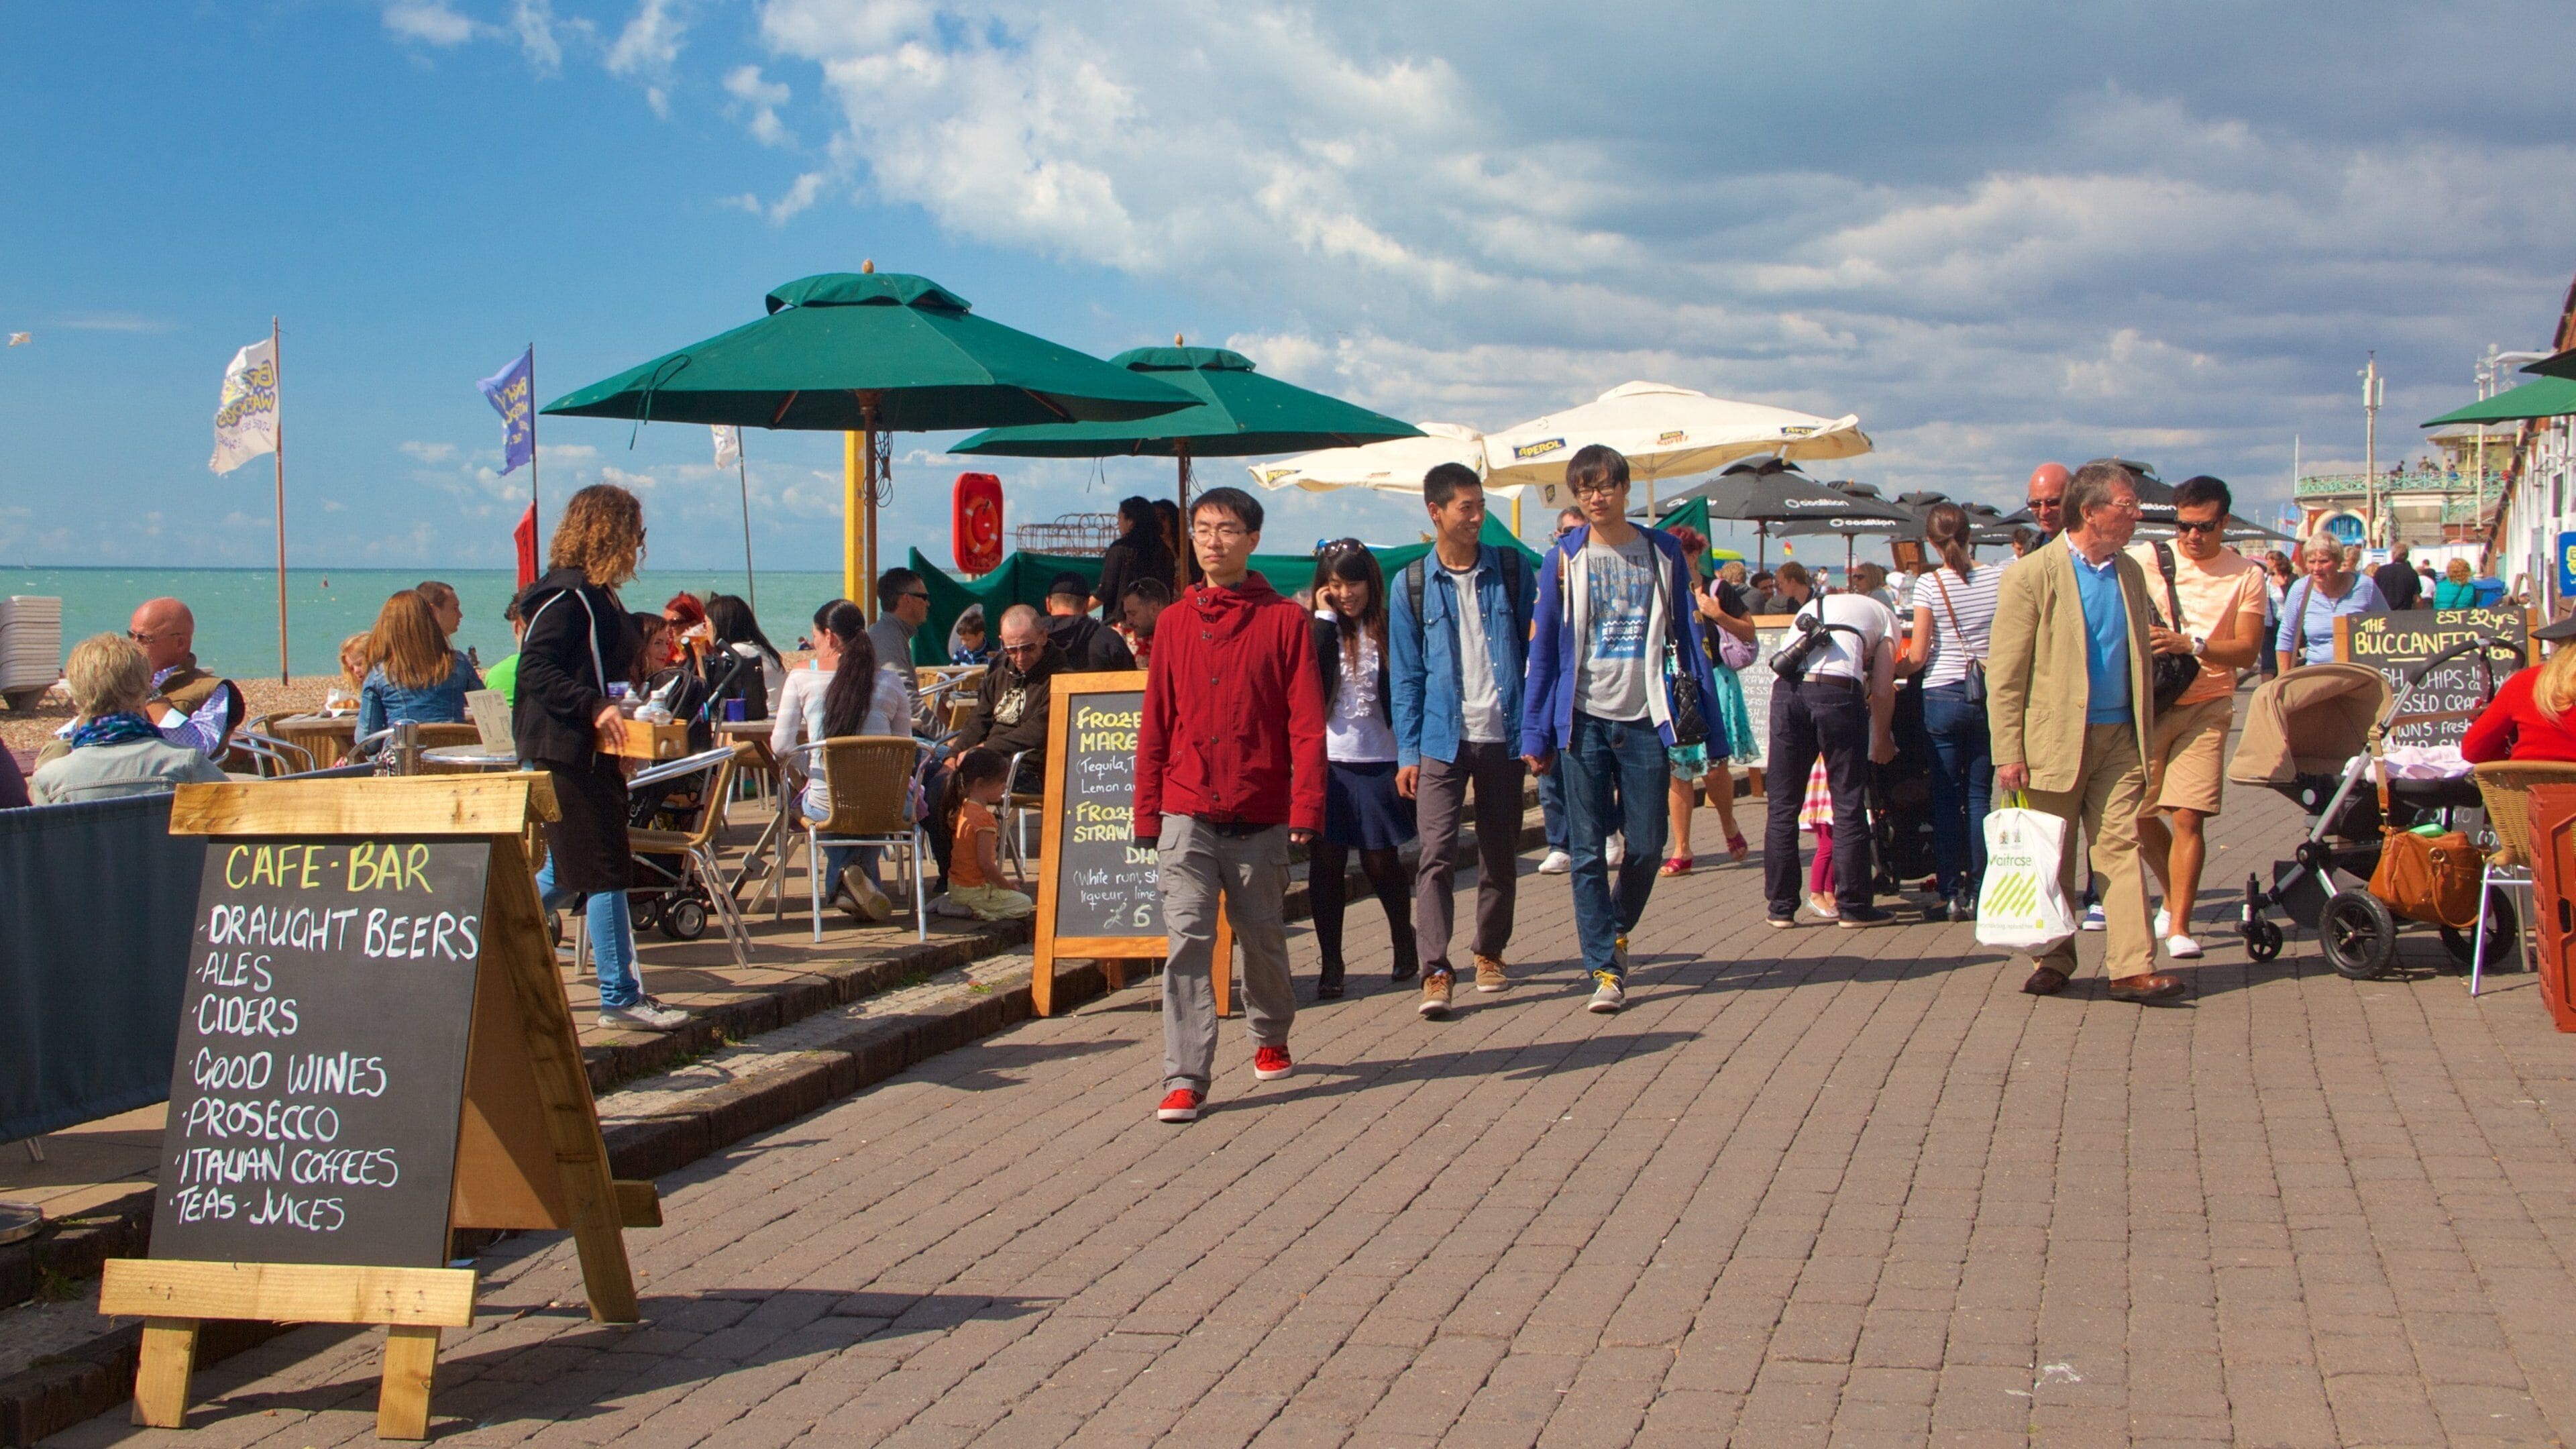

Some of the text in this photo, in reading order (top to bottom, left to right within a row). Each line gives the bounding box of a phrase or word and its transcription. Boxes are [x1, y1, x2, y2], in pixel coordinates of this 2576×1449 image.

[1519, 439, 1562, 458] APEROL
[1799, 498, 1850, 507] coalition
[1845, 519, 1896, 527] coalition
[2361, 617, 2387, 633] THE
[2436, 610, 2467, 625] EST
[2380, 668, 2404, 687] SH
[1076, 706, 1143, 729] FROZE
[2398, 721, 2433, 737] WNS
[1080, 731, 1139, 753] MARG
[1081, 779, 1119, 794] Lemon
[1076, 801, 1135, 822] FROZE
[1073, 820, 1135, 843] STRAW
[209, 904, 479, 961] DRAUGHT BEERS
[202, 953, 272, 993] ALES
[198, 994, 299, 1038] CIDERS
[193, 1047, 388, 1097] GOOD WINES
[186, 1097, 339, 1142] PROSECCO
[179, 1143, 399, 1188] ITALIAN COFFEES
